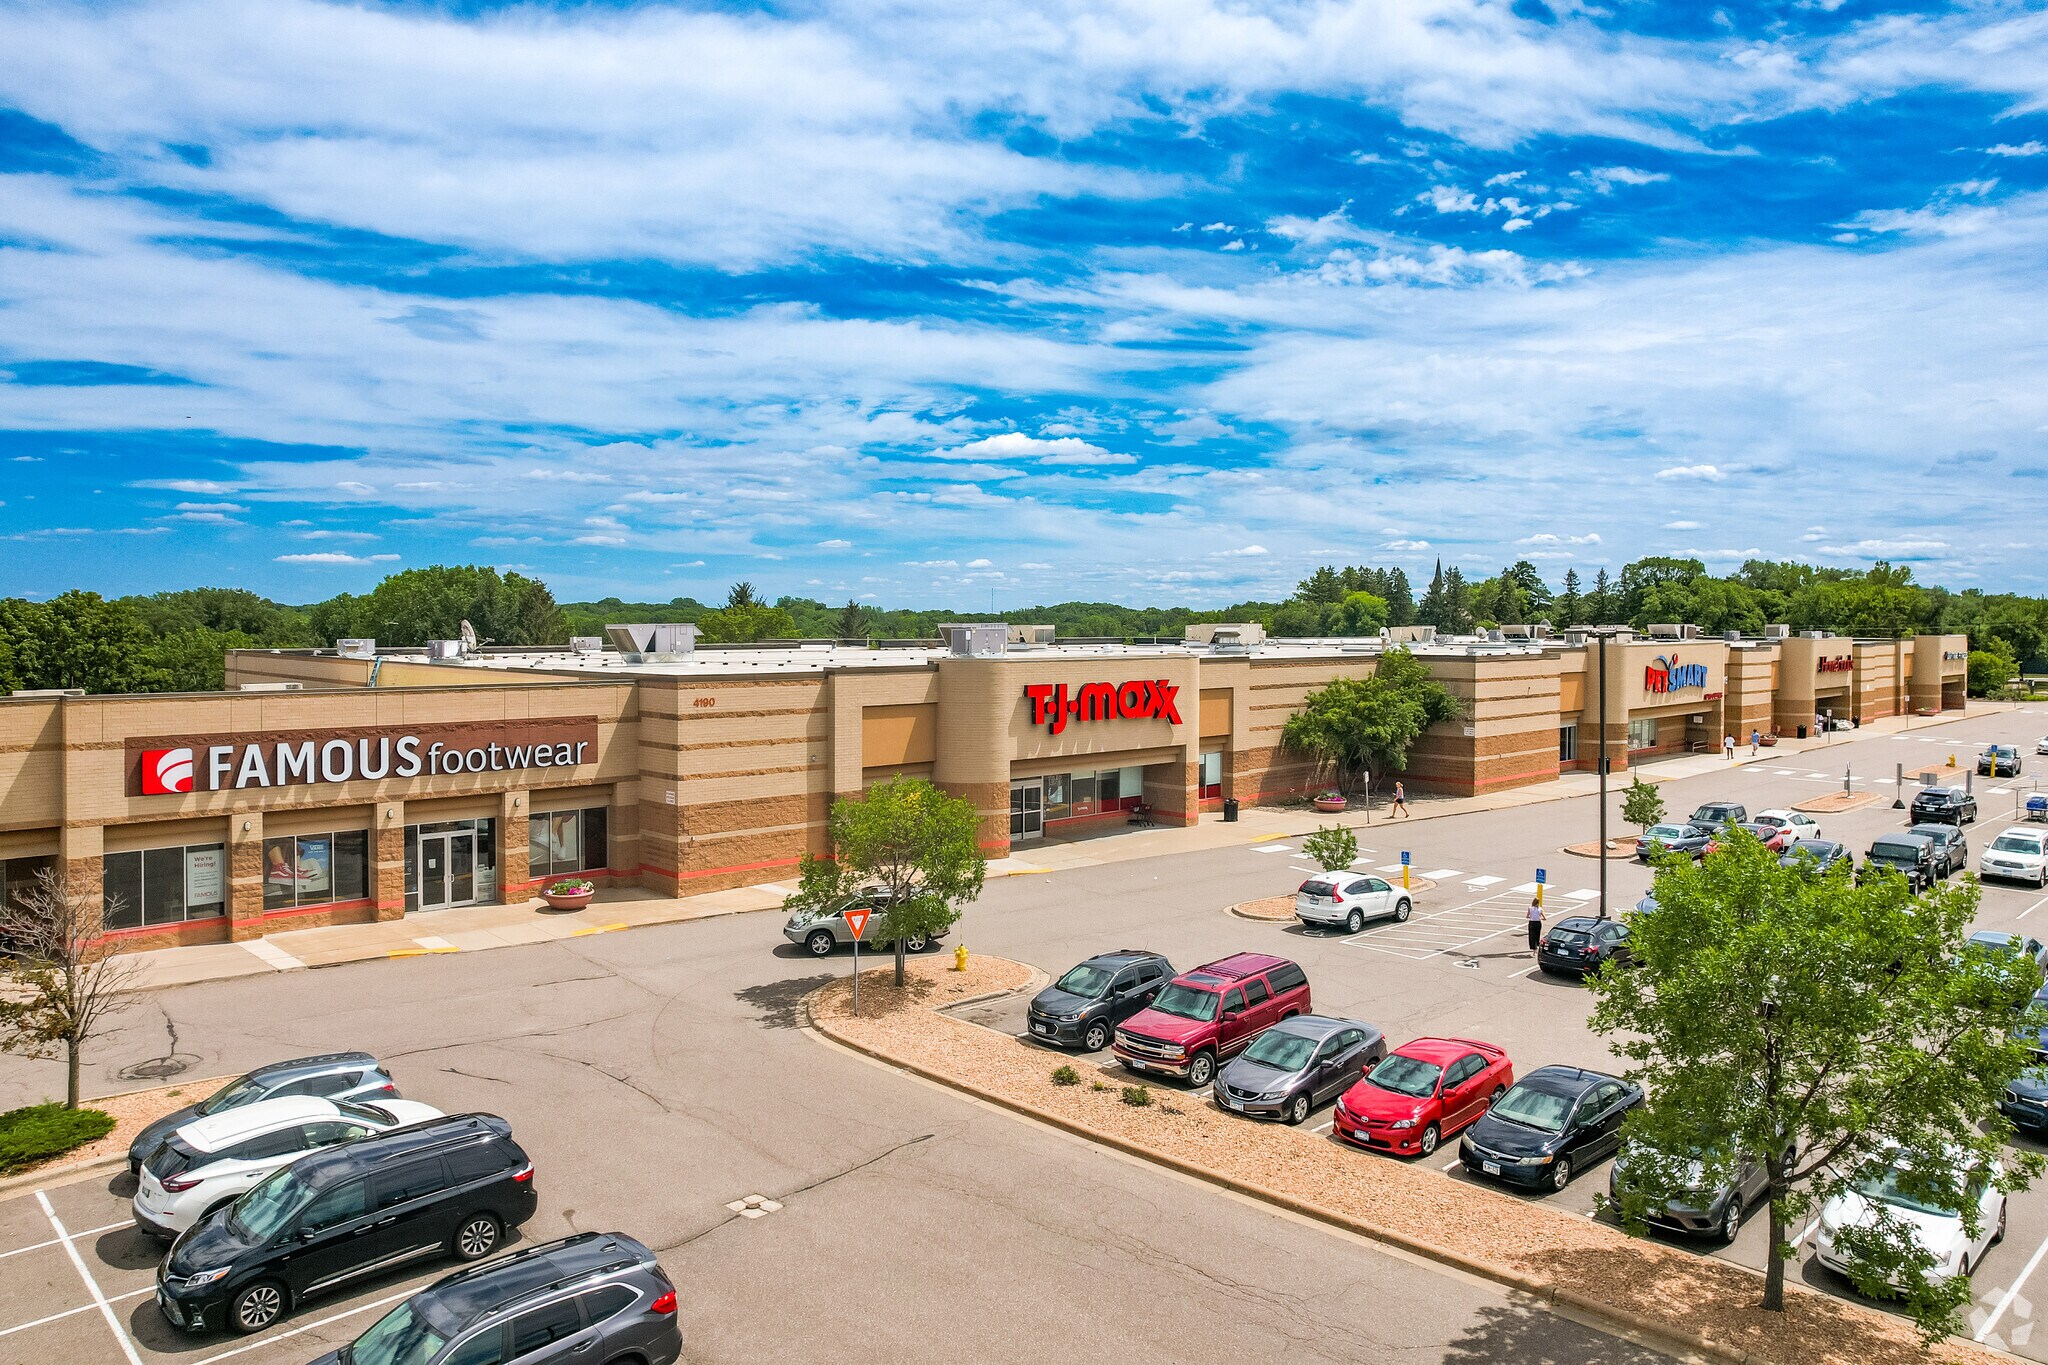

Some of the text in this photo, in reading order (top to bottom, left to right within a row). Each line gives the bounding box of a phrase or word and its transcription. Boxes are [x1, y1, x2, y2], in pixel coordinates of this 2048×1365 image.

[693, 697, 716, 708] 4190
[209, 735, 588, 790] FAMOUS footwear
[194, 861, 216, 869] Hiring!
